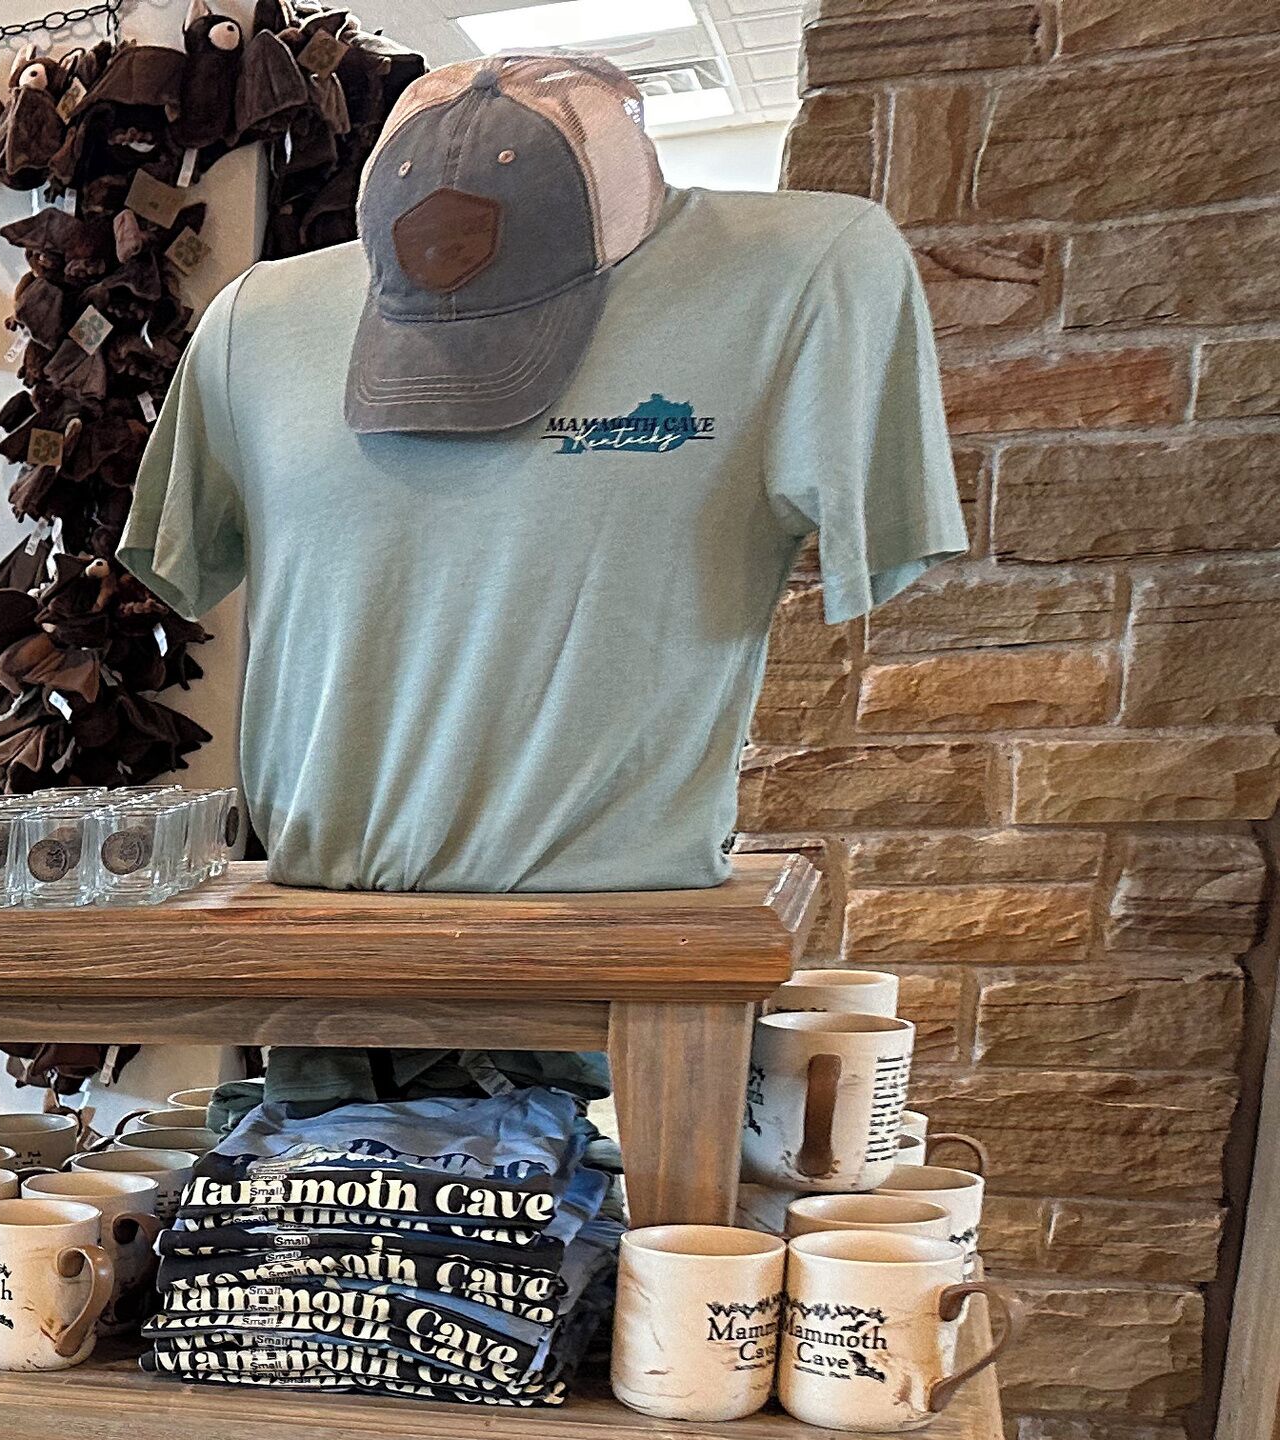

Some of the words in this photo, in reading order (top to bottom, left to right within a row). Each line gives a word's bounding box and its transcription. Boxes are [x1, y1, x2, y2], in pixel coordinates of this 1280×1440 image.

[545, 416, 659, 433] MAMMOTH
[663, 416, 716, 433] CAVE
[249, 1187, 284, 1197] Small
[436, 1182, 554, 1222] Cave
[276, 1236, 309, 1246] Small
[267, 1251, 300, 1262] Small
[437, 1260, 552, 1301] Cave
[249, 1286, 281, 1295] Small
[241, 1316, 274, 1326] Small
[257, 1335, 289, 1346] Small
[406, 1307, 518, 1364] Cave
[796, 1341, 850, 1370] Cave
